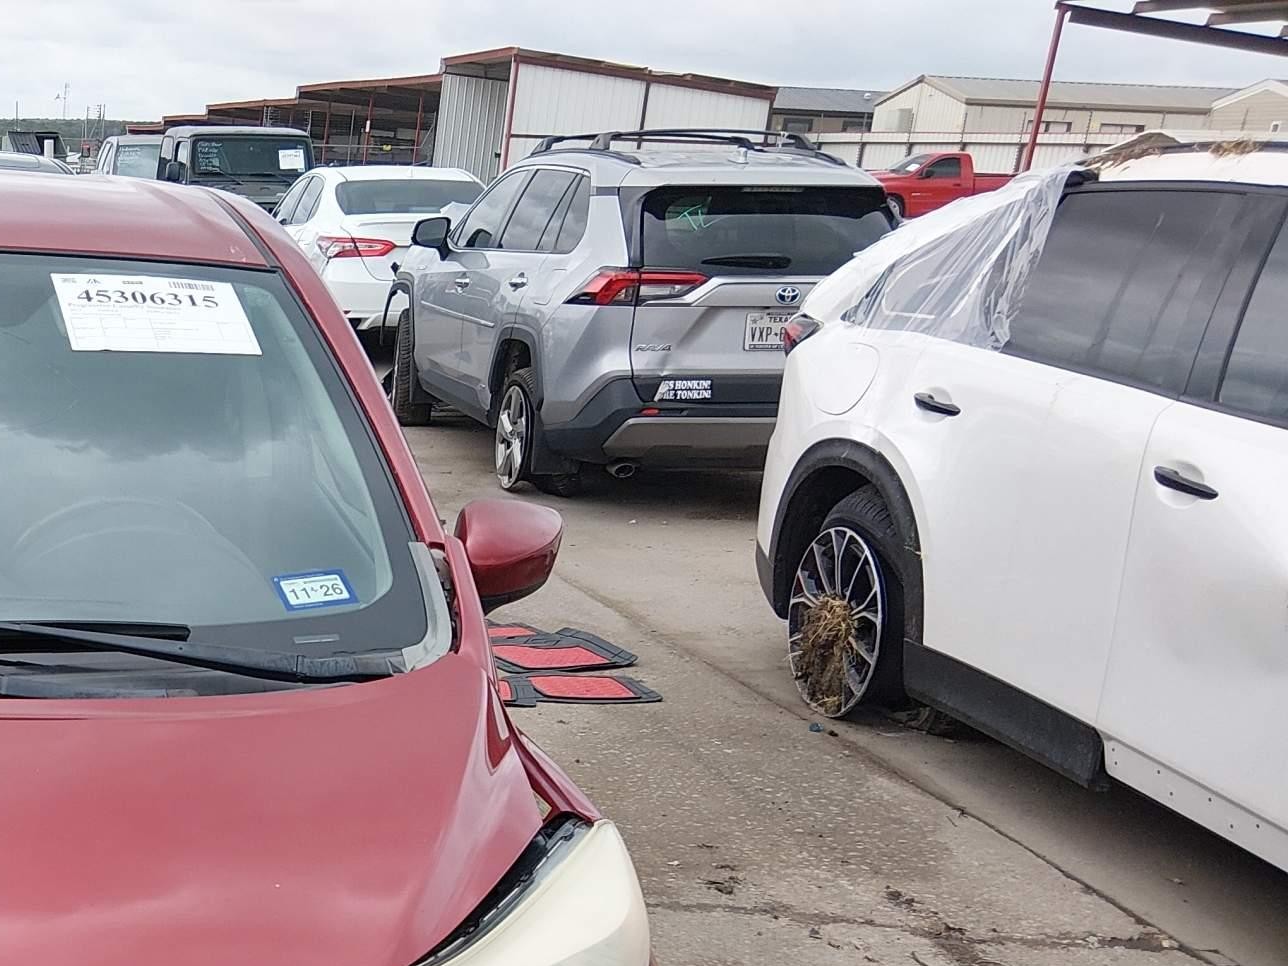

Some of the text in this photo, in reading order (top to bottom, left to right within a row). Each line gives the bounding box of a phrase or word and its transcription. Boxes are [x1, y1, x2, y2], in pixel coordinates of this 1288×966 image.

[77, 289, 219, 308] 45306315
[674, 380, 712, 390] HONKIN!
[676, 390, 712, 400] TONKIN!
